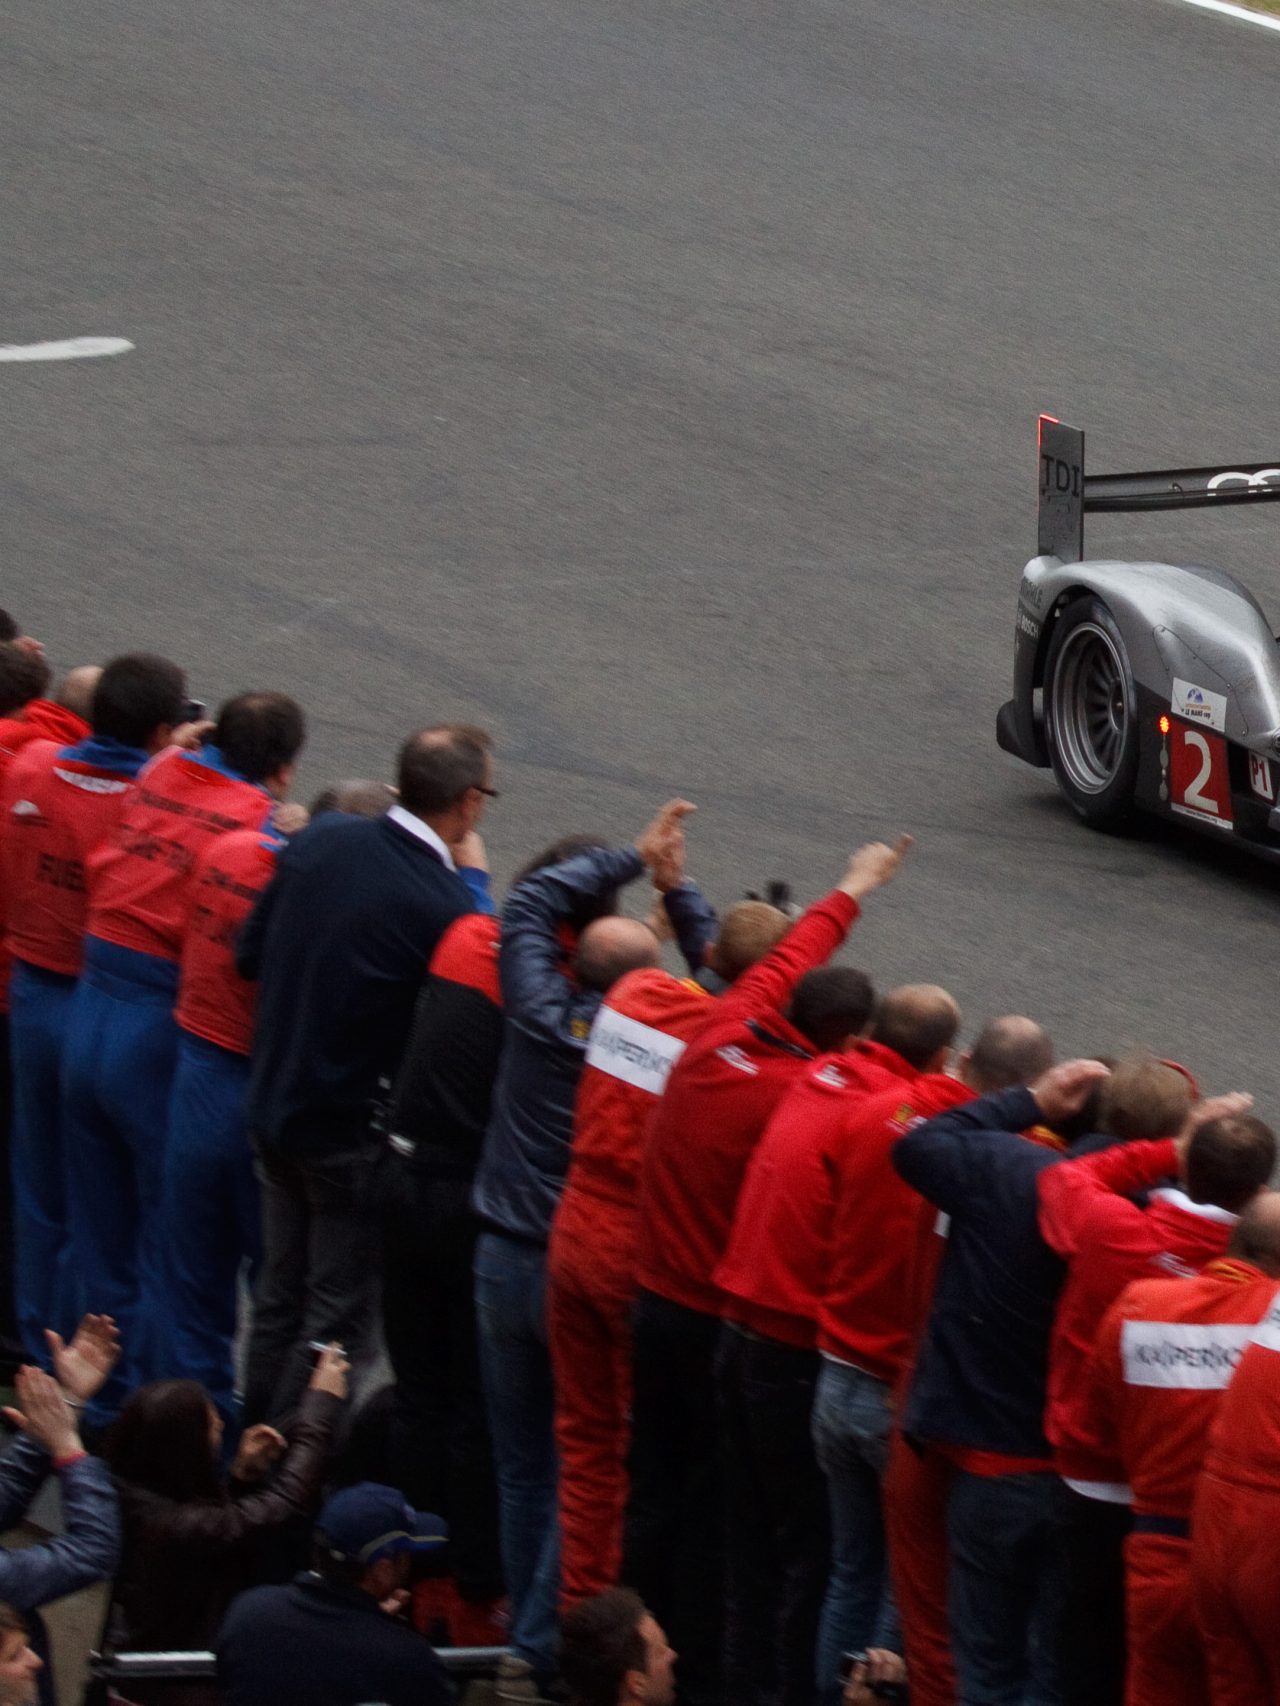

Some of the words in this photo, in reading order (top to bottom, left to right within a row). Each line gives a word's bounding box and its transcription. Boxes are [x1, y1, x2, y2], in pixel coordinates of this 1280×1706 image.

[1041, 454, 1080, 497] TDI
[1184, 730, 1219, 814] 2
[1250, 753, 1268, 793] P1
